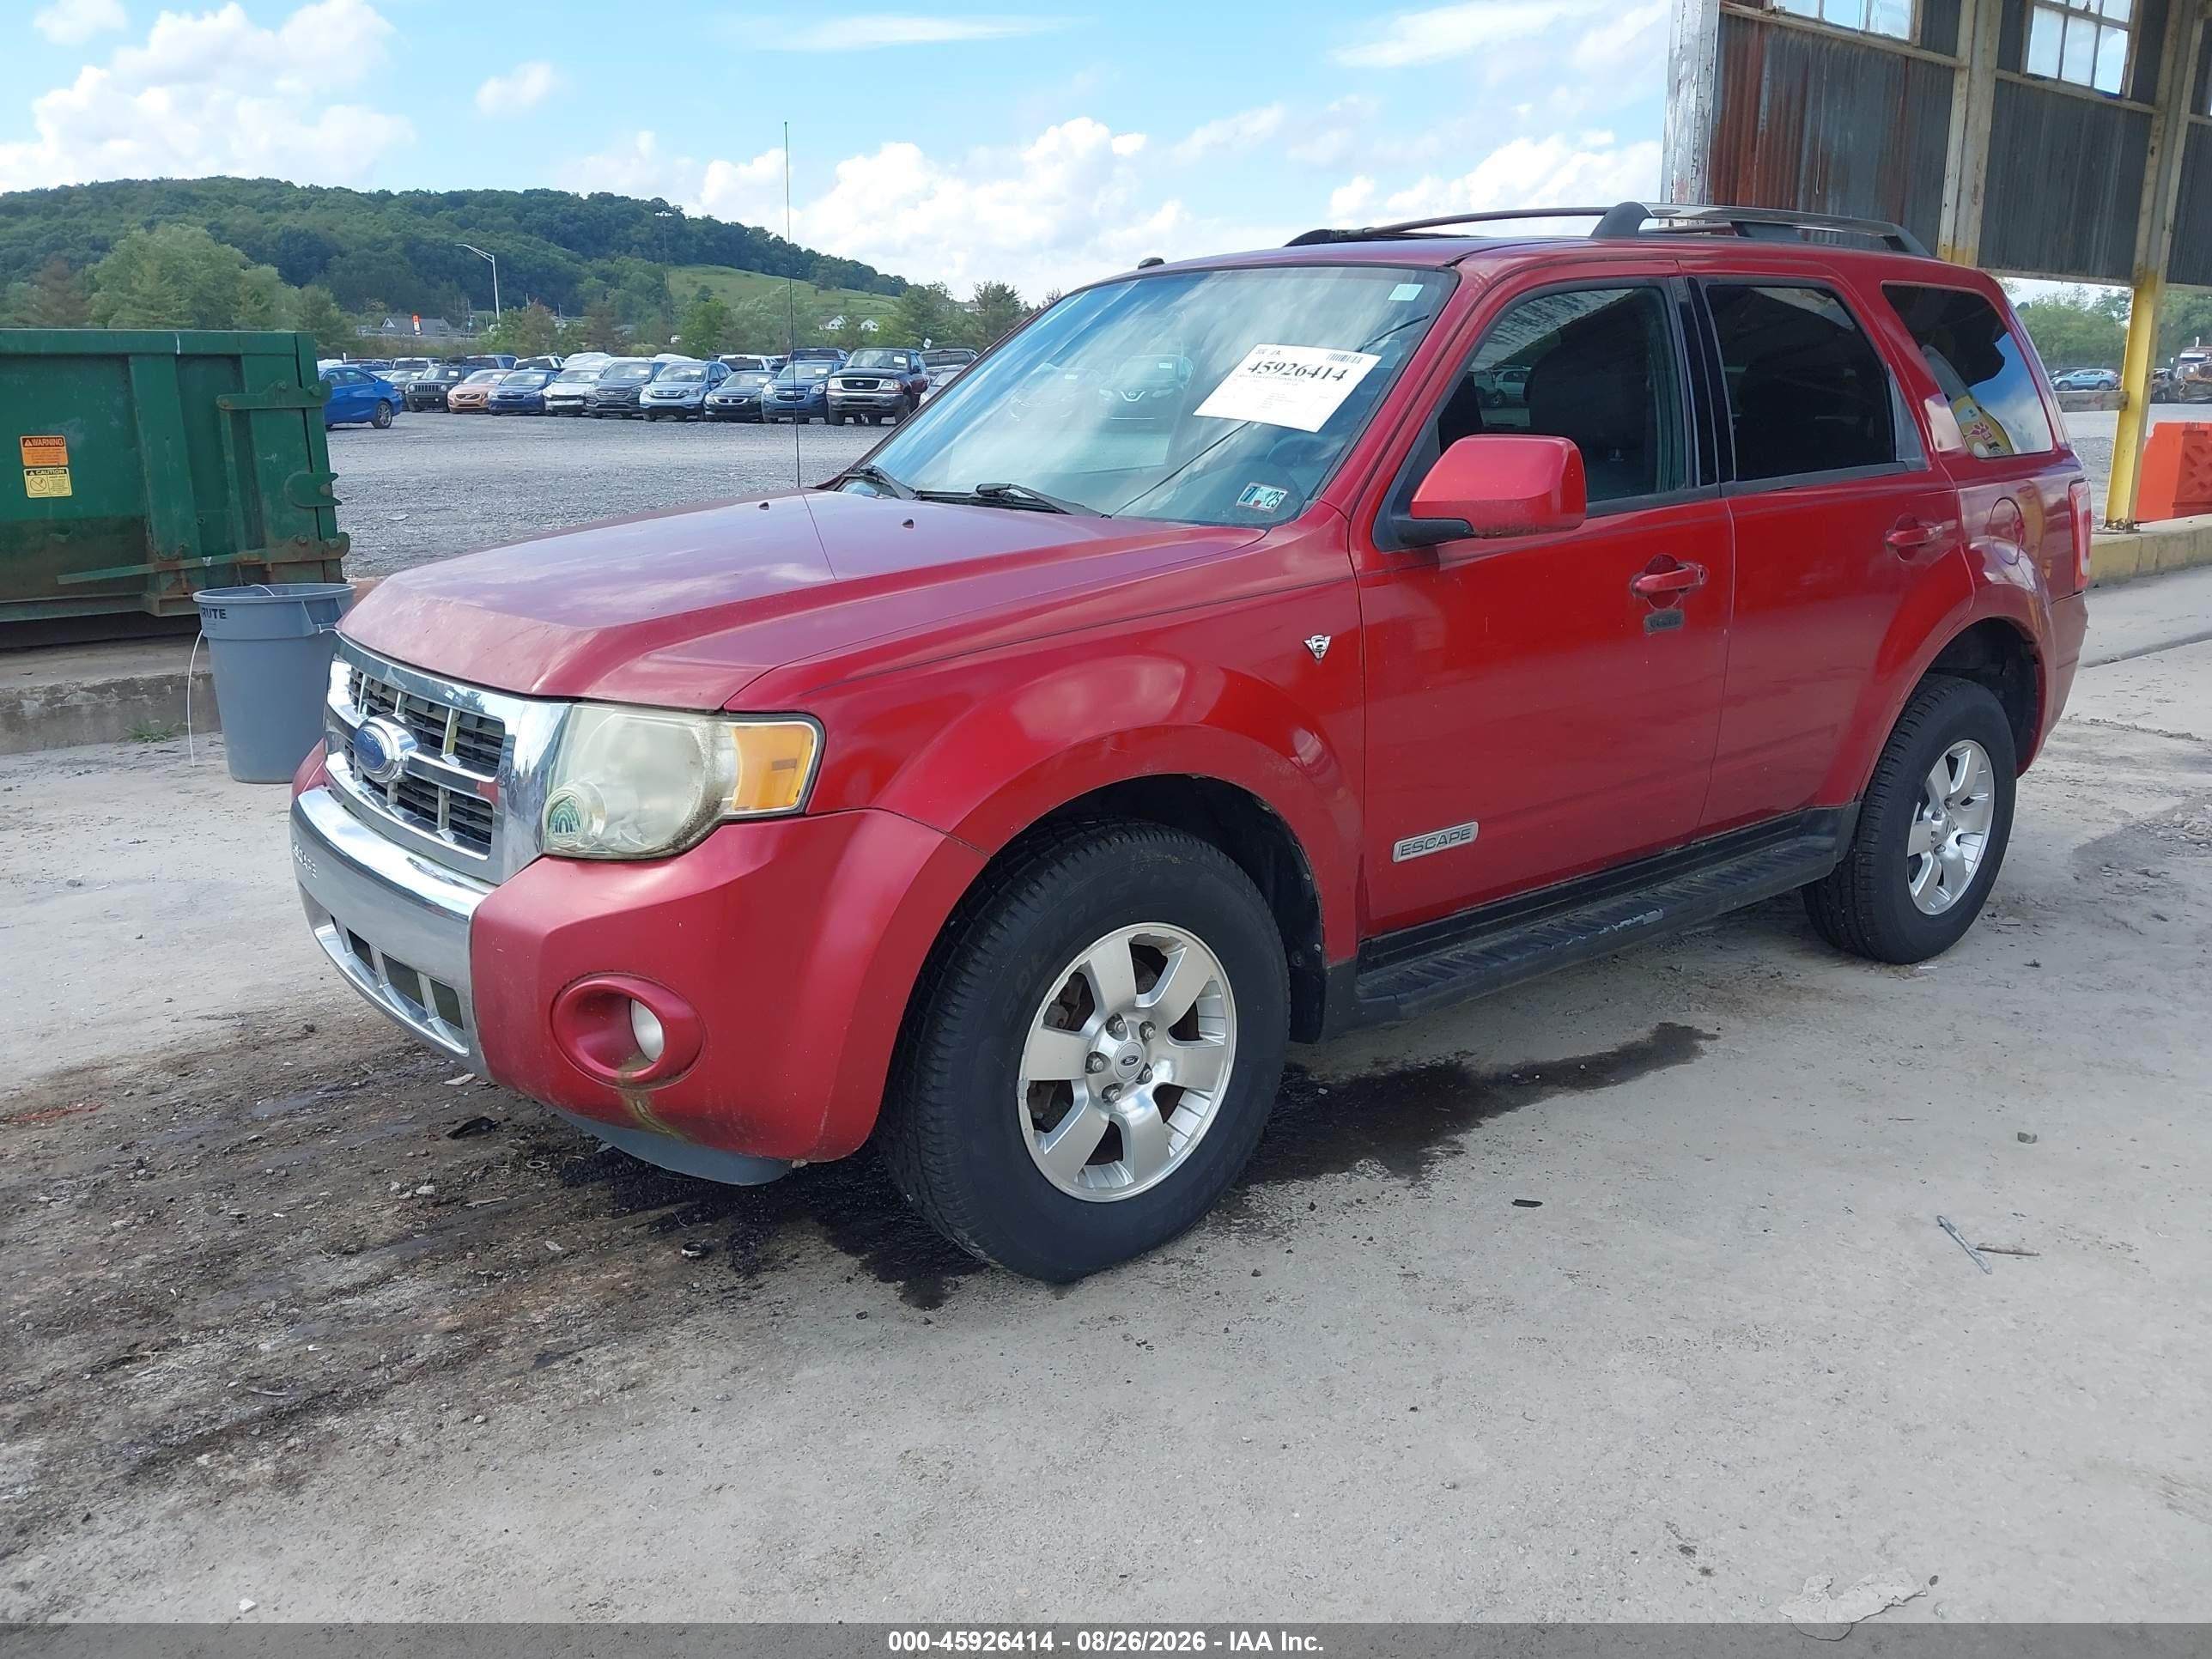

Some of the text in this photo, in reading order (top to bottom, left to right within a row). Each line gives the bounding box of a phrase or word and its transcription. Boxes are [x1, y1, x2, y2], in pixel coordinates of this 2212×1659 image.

[1247, 360, 1350, 382] 45926414
[32, 438, 64, 447] WARNING
[1265, 490, 1285, 508] 25
[201, 606, 228, 619] RUTE
[1400, 827, 1472, 857] ESCAPE
